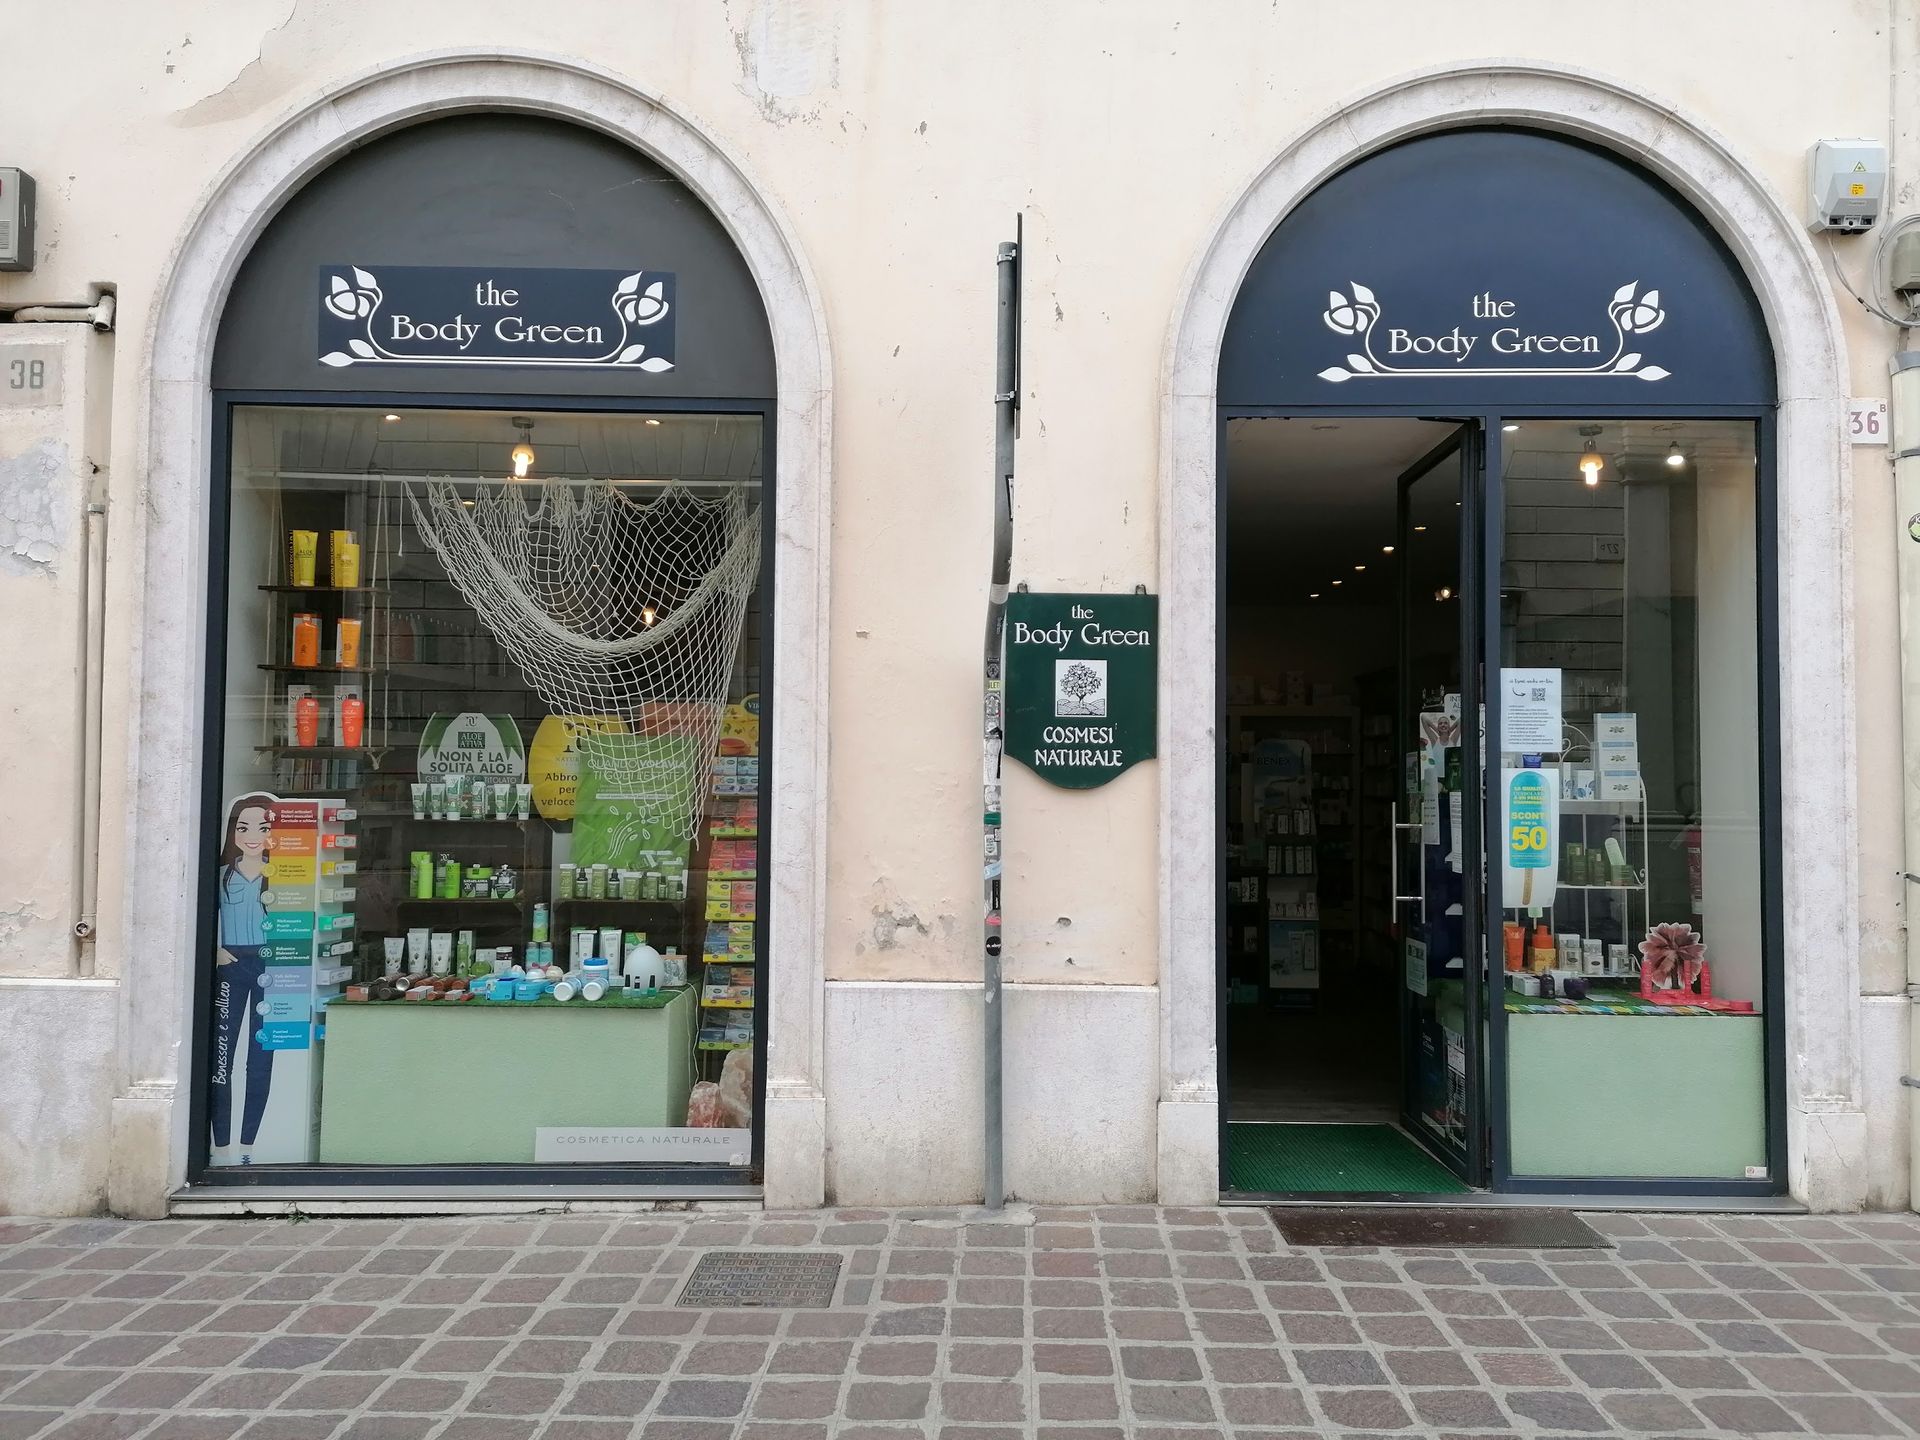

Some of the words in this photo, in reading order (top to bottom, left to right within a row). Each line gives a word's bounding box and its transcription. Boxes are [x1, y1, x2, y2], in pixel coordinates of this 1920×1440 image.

[476, 280, 519, 307] the
[1472, 291, 1516, 318] the
[390, 314, 482, 350] Body
[494, 315, 604, 344] Green
[1388, 327, 1478, 363] Body
[1491, 328, 1601, 353] Green
[1071, 604, 1094, 619] the
[1014, 621, 1074, 652] Body
[1081, 622, 1151, 646] Green
[460, 732, 484, 741] ALOE
[1043, 726, 1114, 744] COSMESI
[439, 752, 475, 763] NON
[477, 748, 484, 763] È
[486, 752, 504, 763] LA
[1034, 749, 1123, 767] NATURALE
[429, 762, 475, 774] SOLITA
[479, 763, 513, 774] ALOE
[559, 786, 577, 796] per
[541, 797, 575, 806] veloce
[1511, 826, 1548, 851] 50
[215, 981, 230, 1019] sollievo
[211, 1035, 228, 1085] Benessere
[556, 1136, 646, 1145] COSMETICA
[652, 1136, 731, 1145] NATURALE
